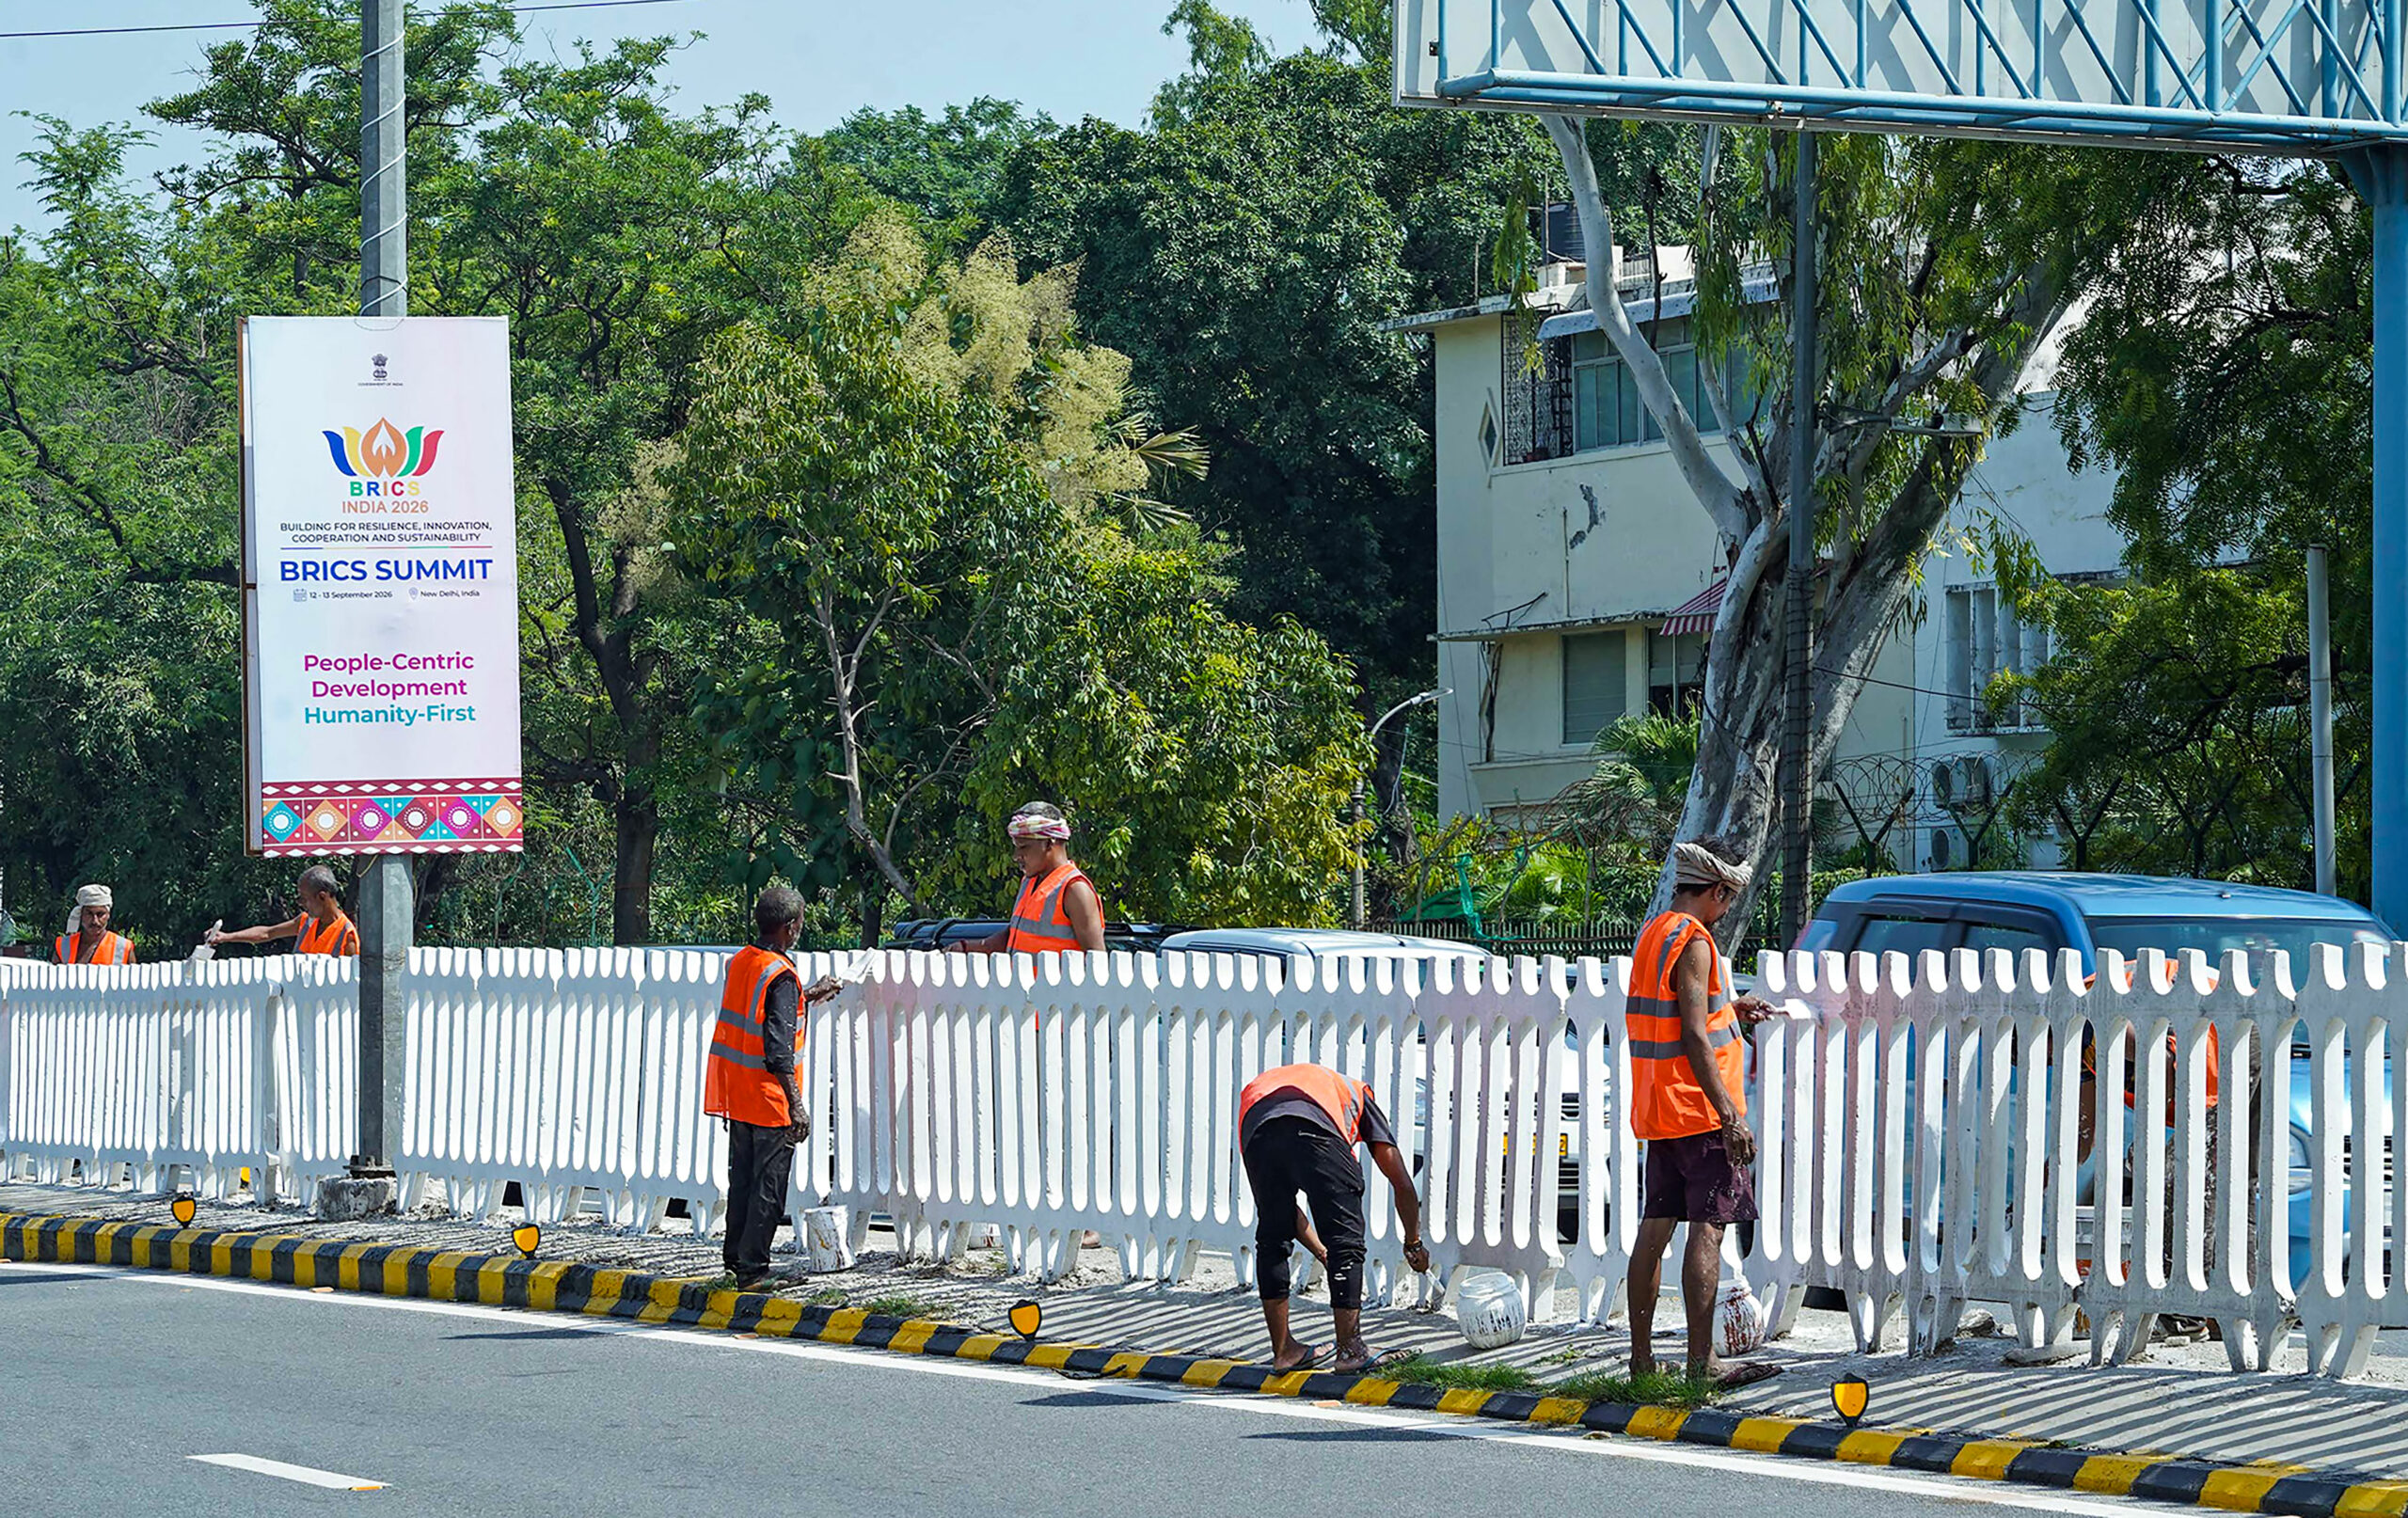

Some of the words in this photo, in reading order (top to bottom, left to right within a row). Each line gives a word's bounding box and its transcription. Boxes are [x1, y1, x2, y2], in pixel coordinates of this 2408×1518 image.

[350, 481, 420, 496] BRICS
[342, 501, 386, 513] INDIA
[392, 501, 429, 513] 2026
[280, 523, 332, 531] BUILDING
[359, 522, 421, 531] RESILIENCE,
[423, 522, 492, 531] INNOVATION,
[292, 534, 369, 542] COOPERATION
[398, 533, 481, 542] SUSTAINABILITY
[281, 561, 367, 581] BRICS
[376, 559, 493, 580] SUMMIT
[332, 591, 372, 600] September
[439, 590, 459, 598] Delhi,
[304, 651, 474, 675] People-Centric
[312, 679, 467, 700] Development
[305, 704, 476, 727] Humanity-First
